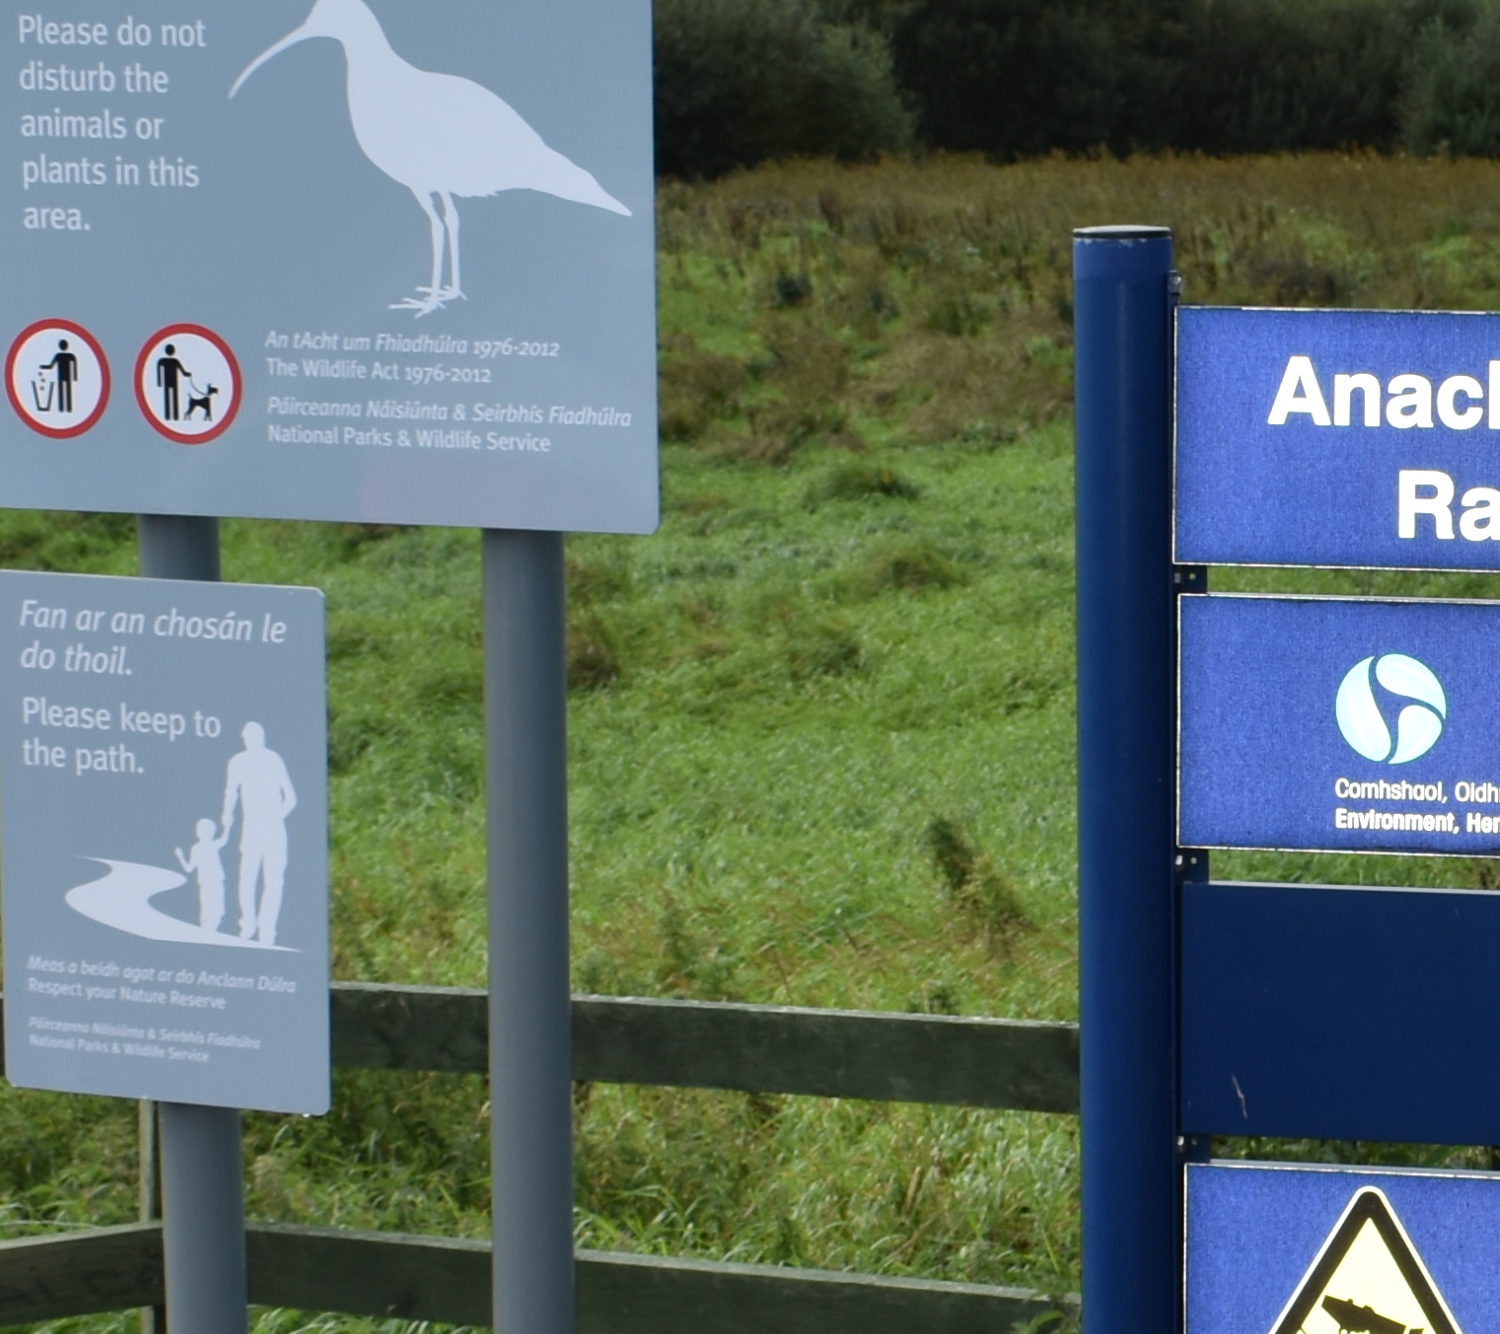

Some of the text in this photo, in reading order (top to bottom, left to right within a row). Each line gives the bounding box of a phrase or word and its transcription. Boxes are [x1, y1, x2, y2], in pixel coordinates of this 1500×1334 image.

[18, 14, 207, 48] Please do not
[18, 60, 169, 94] disturb the
[20, 107, 164, 140] animals or
[22, 153, 200, 190] plants in this
[23, 206, 91, 231] area.
[264, 330, 561, 359] An tAcht um Fhiadhúlra 1976-2012
[266, 357, 492, 385] The Wildlife Act 1976-2012
[267, 396, 632, 427] Páirceanna Náisiúnta & Seirbhís Fiadhúlra
[268, 424, 551, 453] National Parks & Wildlife Service
[19, 599, 287, 644] Fan ar an chosán le
[20, 640, 133, 676] do thoil.
[22, 696, 222, 742] Please keep to
[22, 737, 144, 776] the path.
[1335, 778, 1447, 803] Comhshaol,
[1336, 808, 1459, 834] Environment,
[27, 977, 227, 1010] Respect your Nature Reserve
